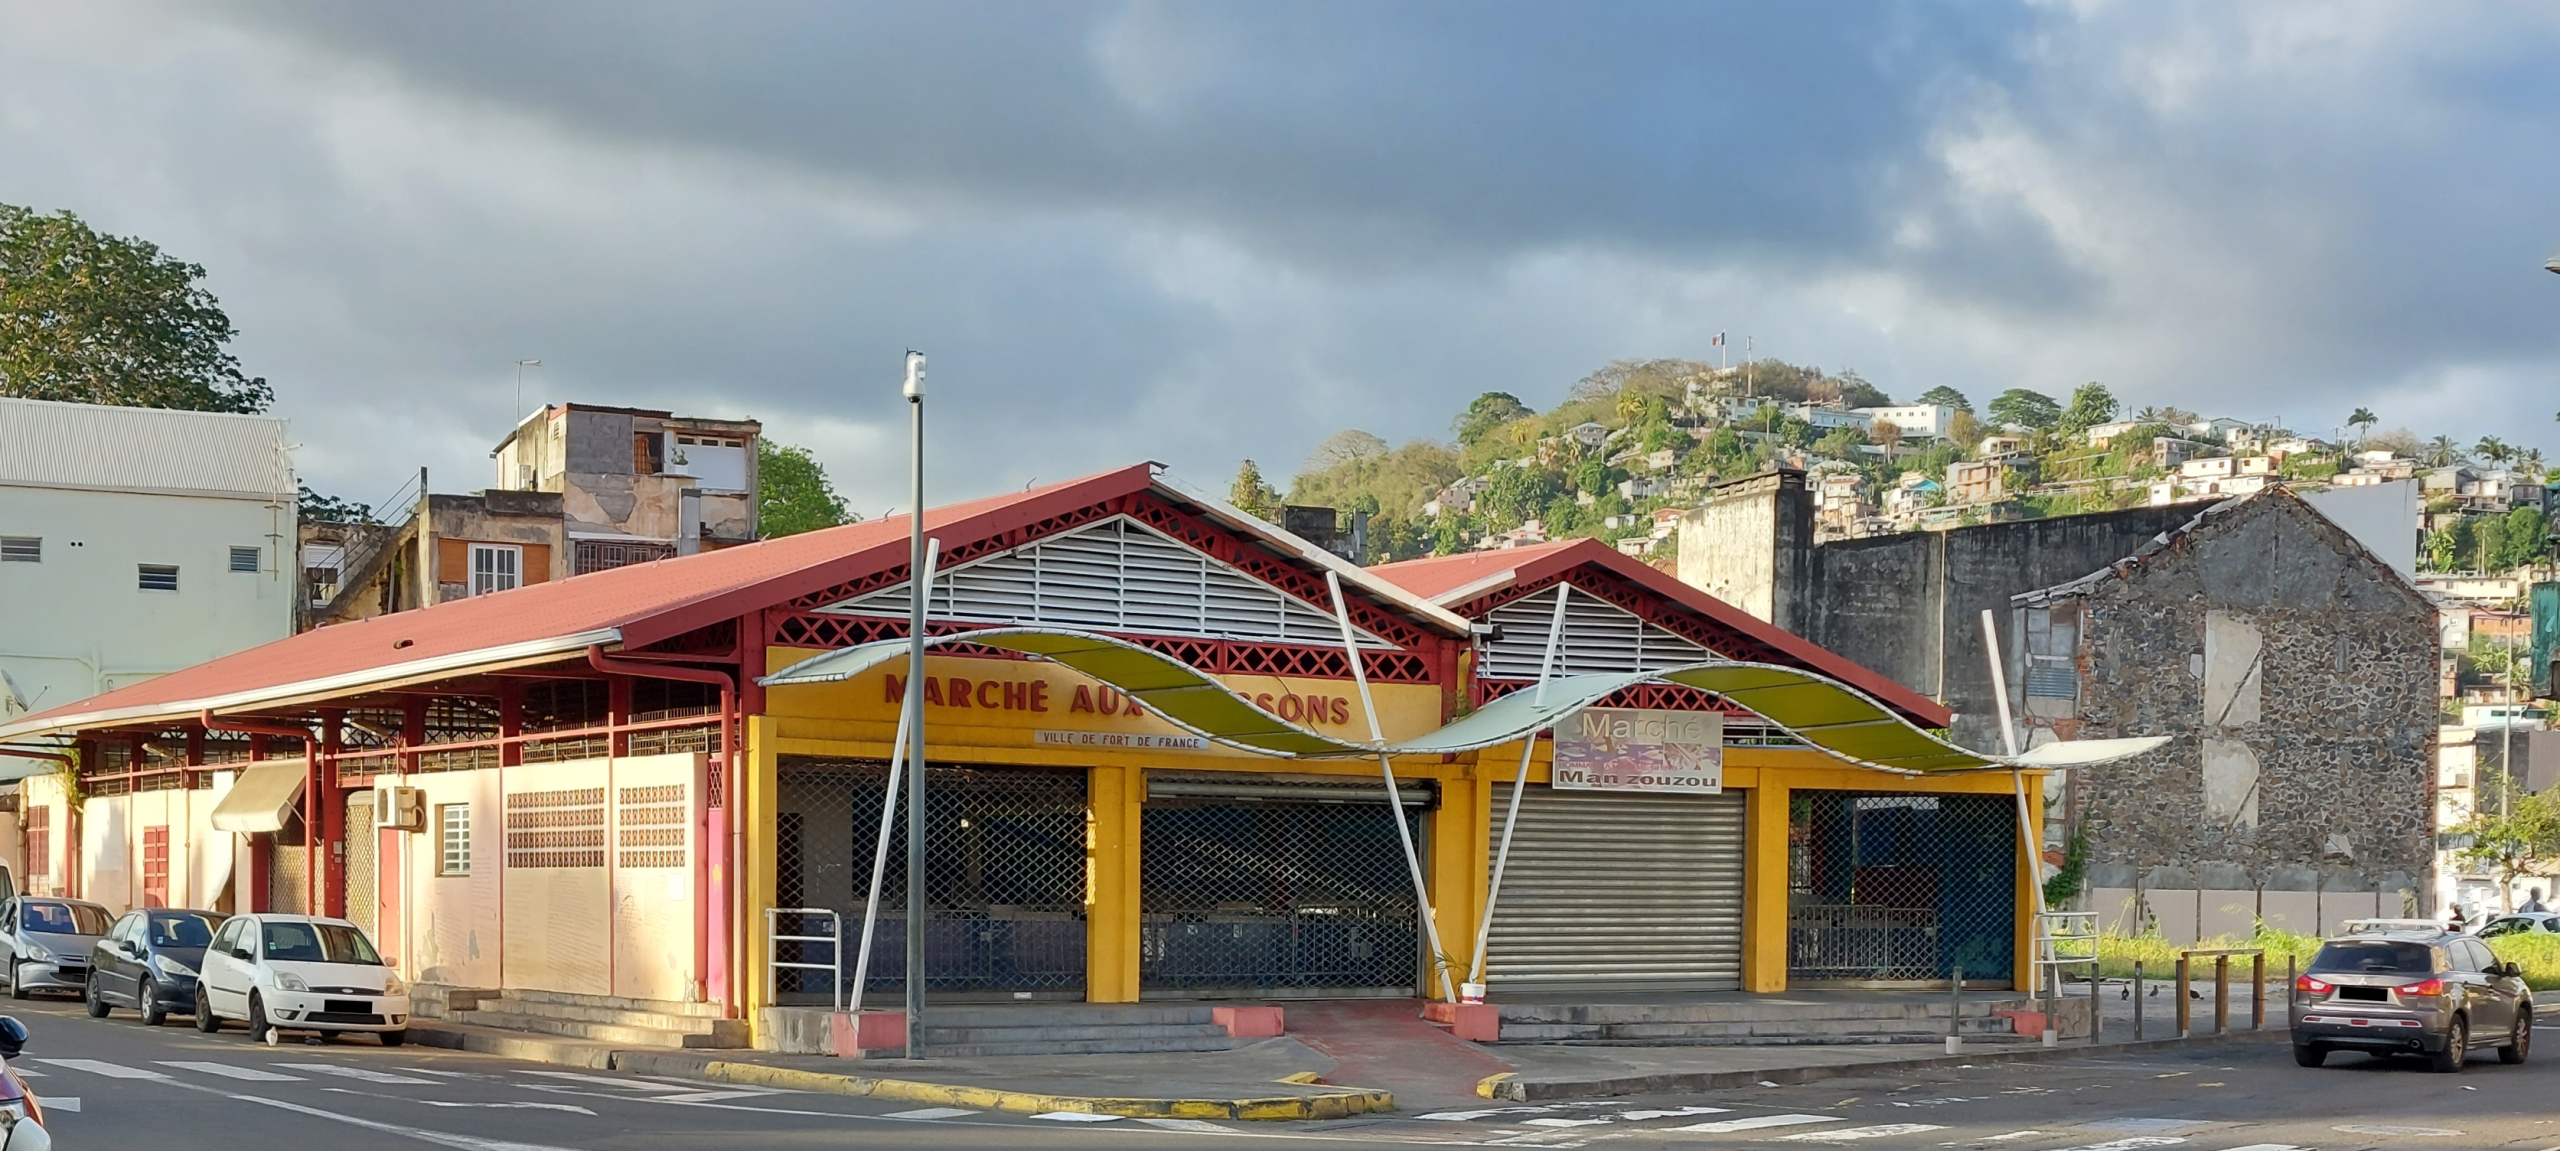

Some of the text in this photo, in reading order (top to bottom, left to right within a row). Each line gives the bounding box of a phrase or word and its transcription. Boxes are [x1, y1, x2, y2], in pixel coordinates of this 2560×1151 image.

[1582, 712, 1702, 739] Marché
[1043, 732, 1200, 749] VILLE DE FORT DE FRANCE
[1559, 770, 1717, 787] Man zouzou
